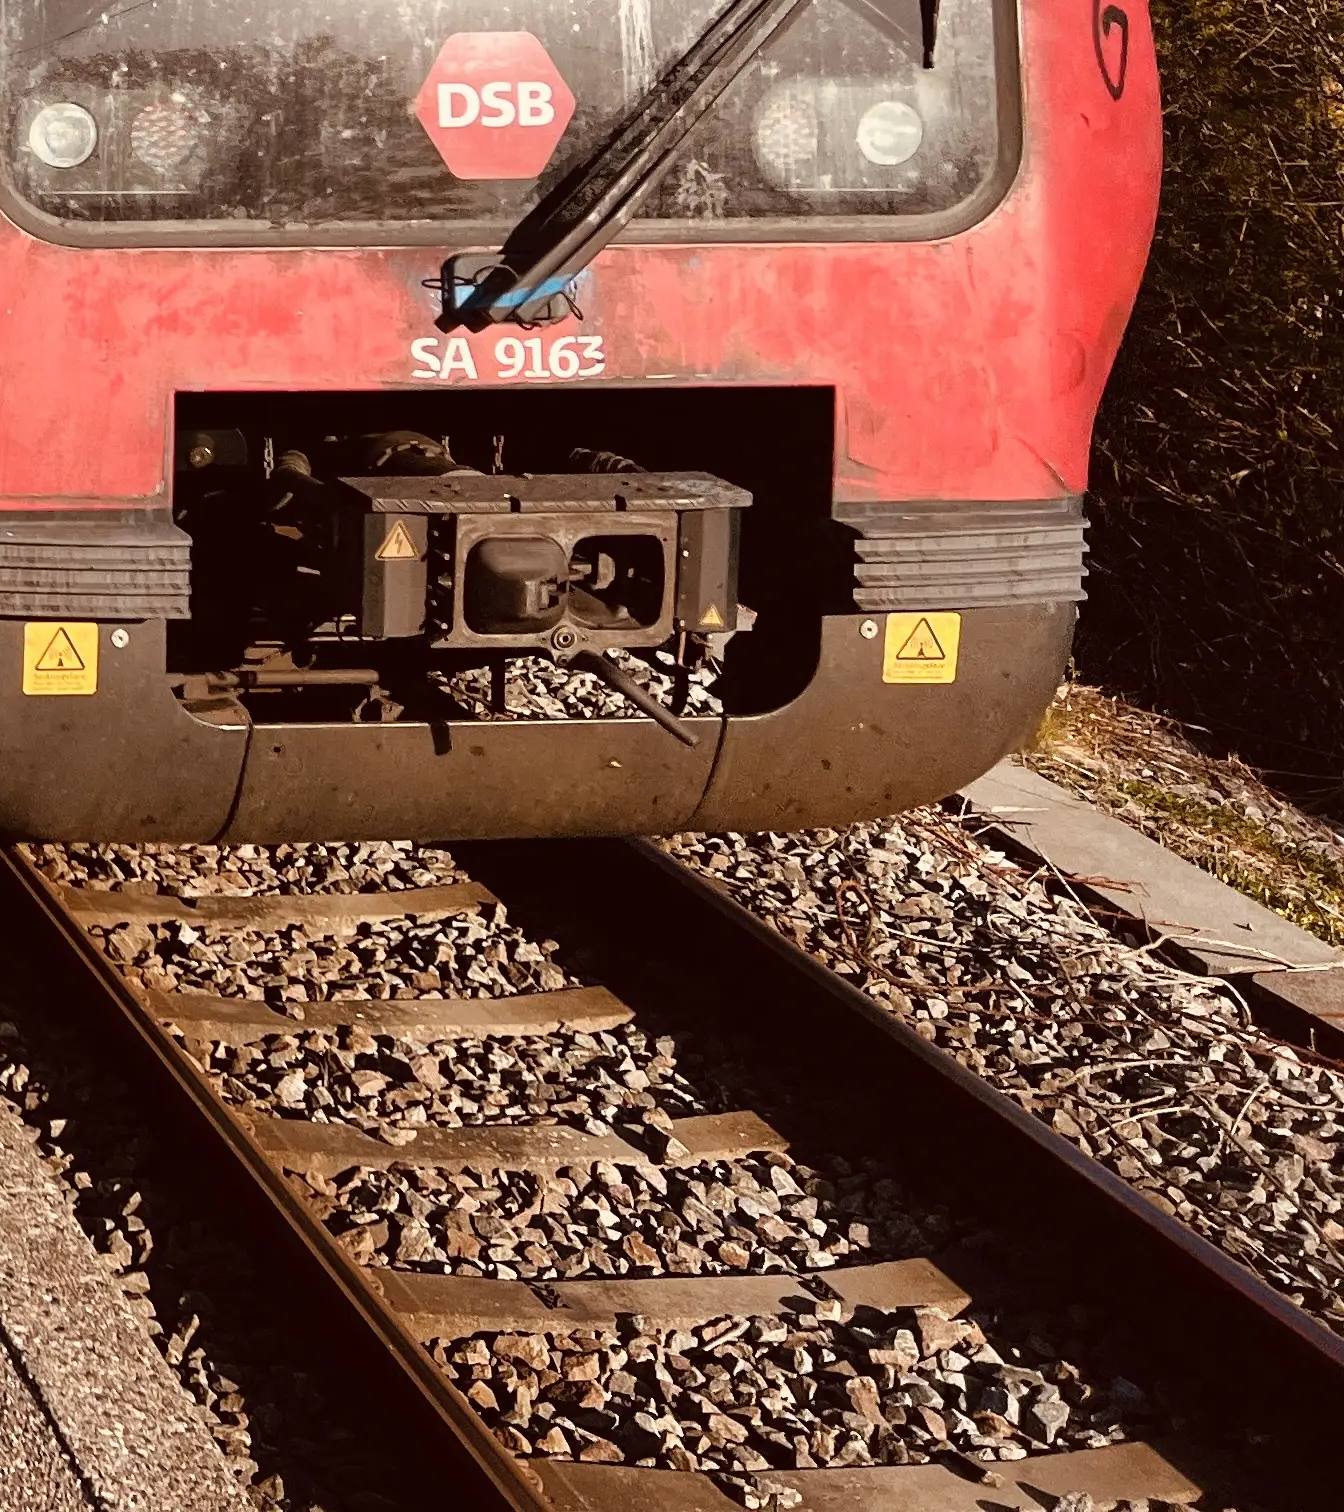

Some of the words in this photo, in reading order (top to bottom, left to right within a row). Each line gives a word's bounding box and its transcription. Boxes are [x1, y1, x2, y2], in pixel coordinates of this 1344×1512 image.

[436, 81, 556, 129] DSB
[411, 336, 478, 380] SA
[494, 335, 606, 379] 9163
